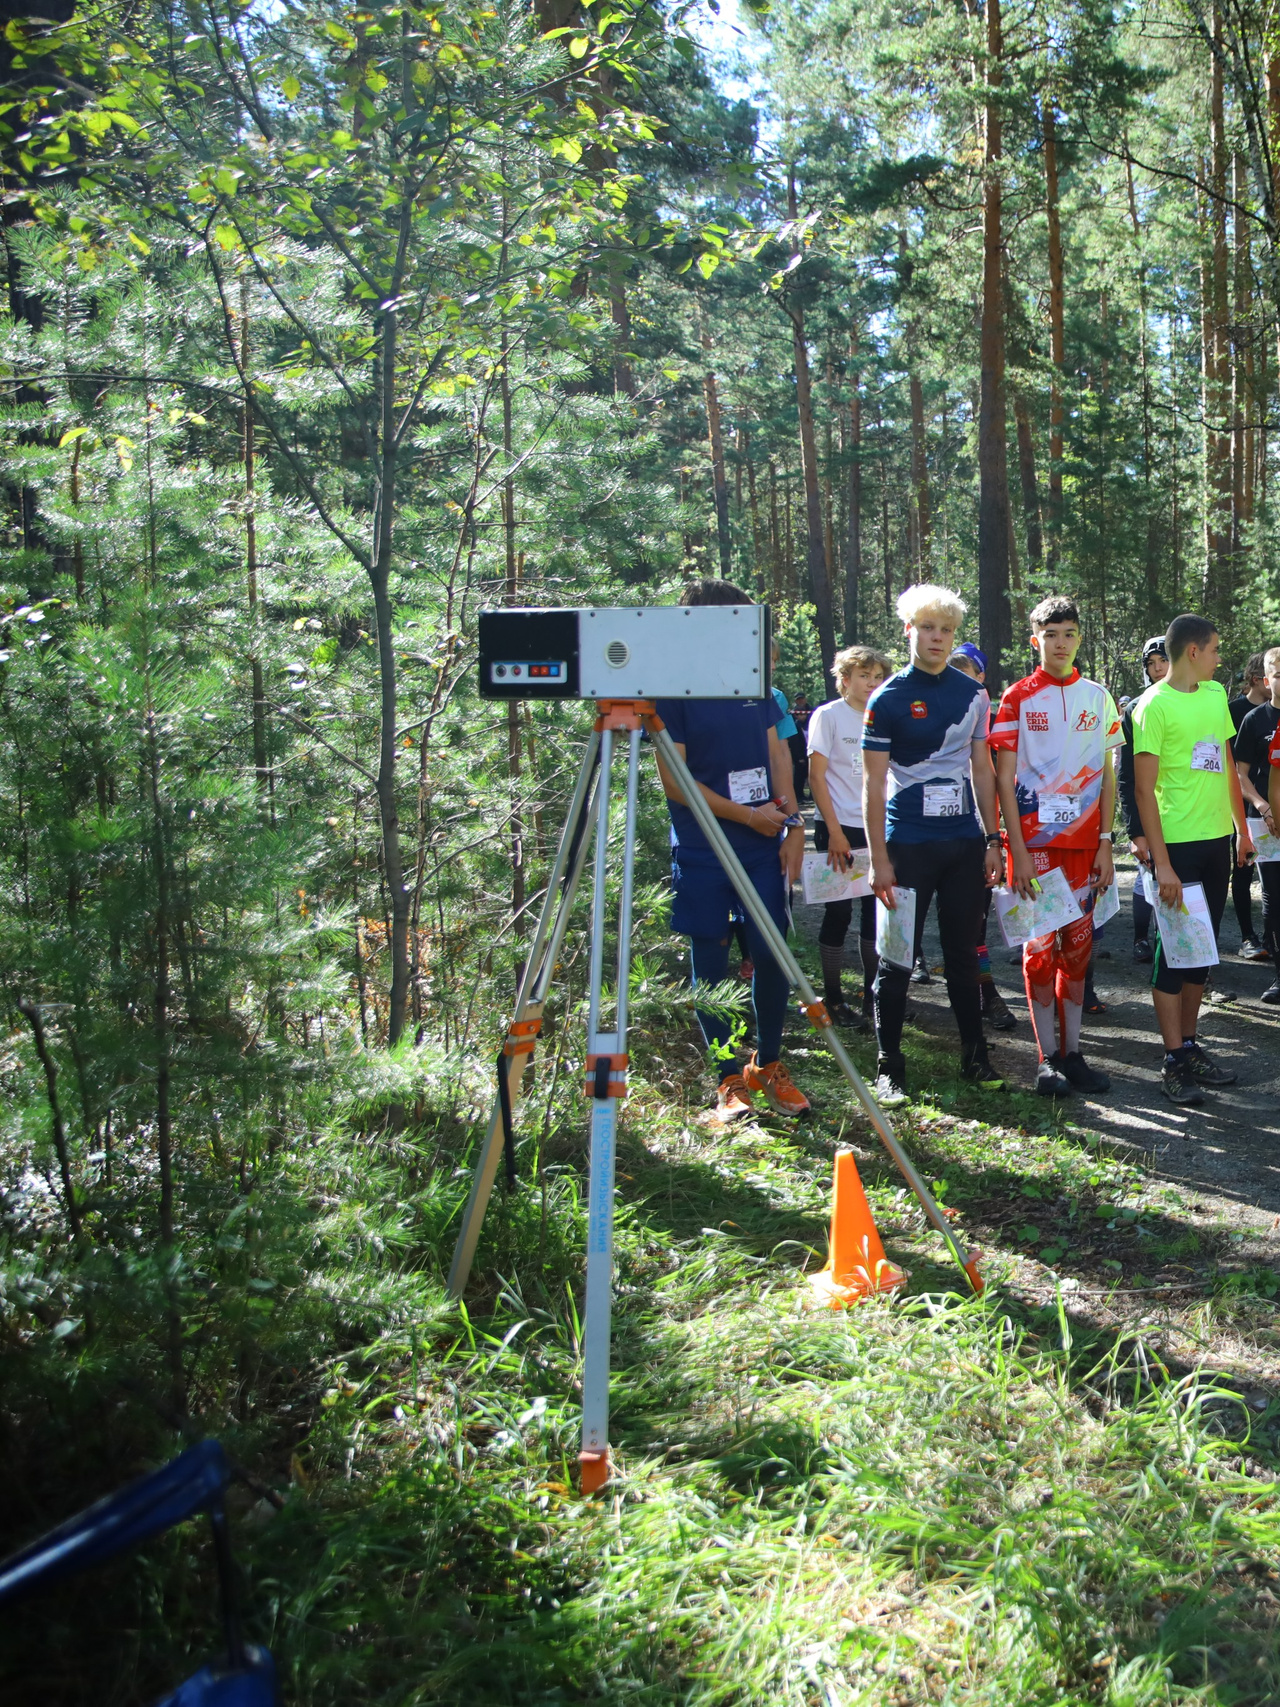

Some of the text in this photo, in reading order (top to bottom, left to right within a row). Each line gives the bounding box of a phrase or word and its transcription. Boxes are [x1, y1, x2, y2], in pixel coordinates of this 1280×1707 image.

[1203, 759, 1220, 771] 204
[749, 787, 767, 801] 201
[940, 804, 960, 816] 202
[1054, 811, 1076, 822] 203
